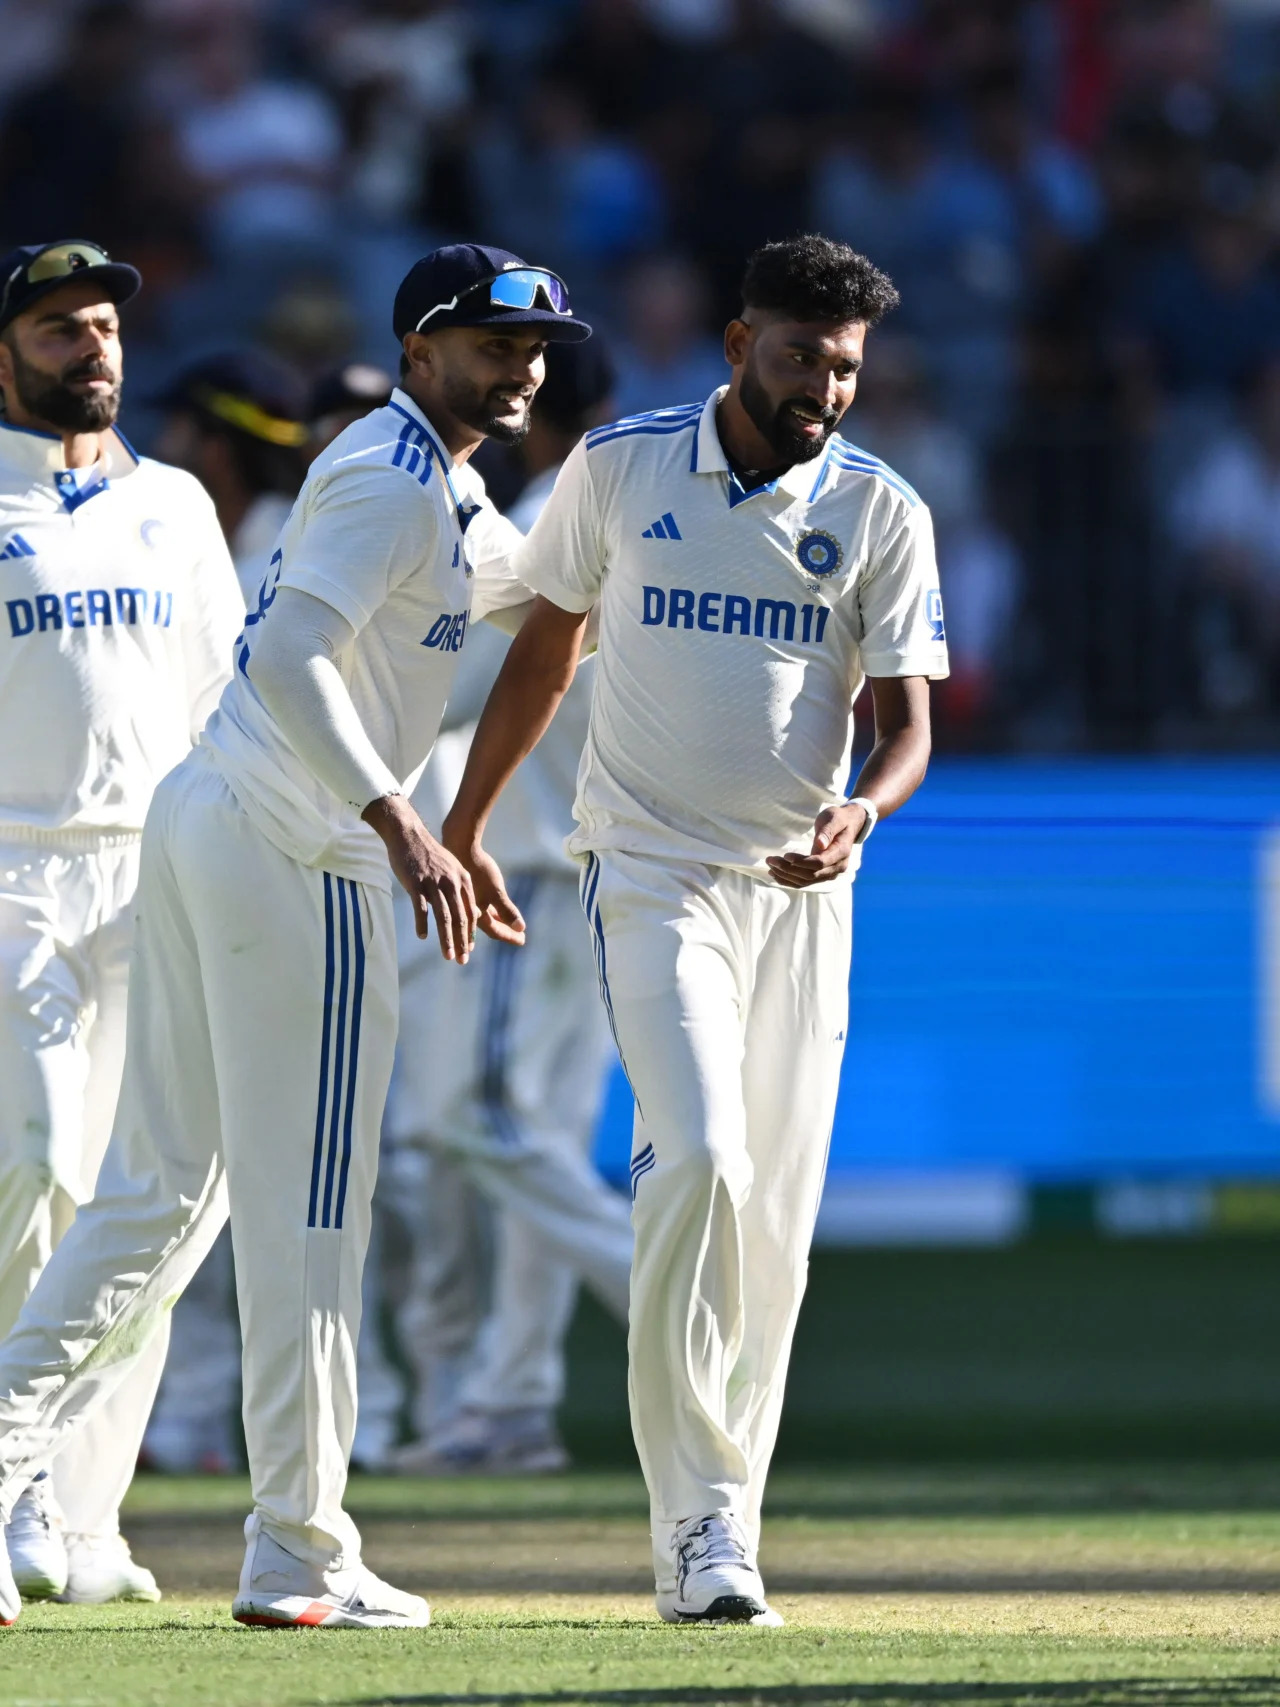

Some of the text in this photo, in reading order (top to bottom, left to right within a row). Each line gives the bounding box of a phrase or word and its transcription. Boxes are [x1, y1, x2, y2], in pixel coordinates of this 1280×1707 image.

[4, 587, 173, 638] DREAM11
[420, 609, 471, 652] DRE
[640, 585, 831, 643] DREAM11
